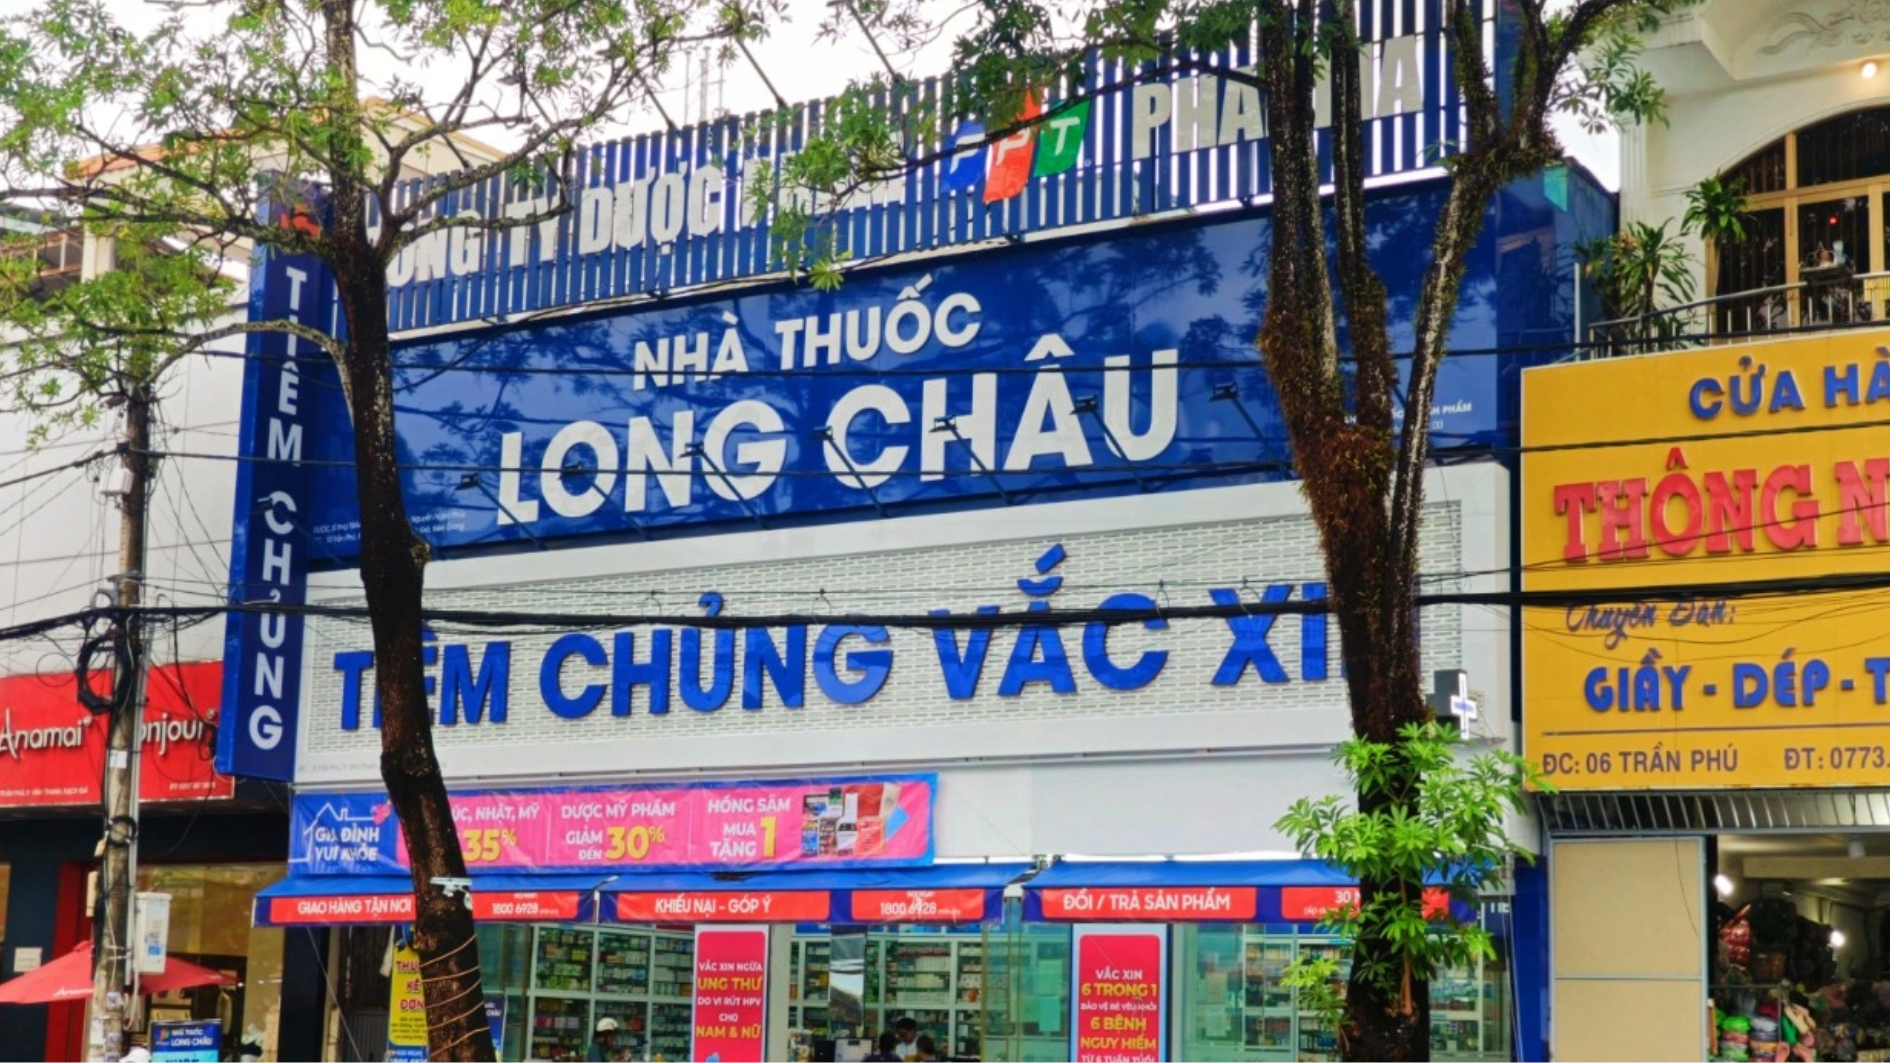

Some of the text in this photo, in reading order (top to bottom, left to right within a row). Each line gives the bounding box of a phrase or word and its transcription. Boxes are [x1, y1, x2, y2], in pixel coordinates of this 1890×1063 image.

[577, 160, 723, 256] DƯỢC
[1132, 34, 1425, 160] PHAA
[634, 274, 983, 391] NHÀ THUỐC
[1689, 355, 1805, 421] CỬA
[497, 333, 1179, 526] LONG CHÂU
[248, 266, 308, 751] TIÊM CHỦNG
[1553, 446, 1820, 564] THÔNG
[540, 591, 894, 720] CHỦNG
[928, 543, 1170, 701] VẮC
[1584, 648, 1692, 712] GIẦY
[1732, 648, 1830, 707] DÉP
[1542, 752, 1580, 775] ĐC:
[1586, 752, 1612, 775] 06
[1618, 741, 1682, 773] TRẦN
[1690, 735, 1739, 772] PHÚ
[1784, 747, 1824, 770] ĐT:
[518, 803, 541, 820] MỸ
[561, 798, 676, 823] DƯỢC MỸ PHẨM
[757, 793, 791, 813] SÂM
[565, 825, 603, 845] GIẢM
[723, 822, 757, 837] MUA
[760, 815, 777, 859] 1
[462, 828, 518, 863] 35%
[578, 846, 602, 861] ĐẾN
[605, 825, 665, 861] 30%
[709, 838, 757, 861] TẶNG
[297, 896, 412, 917] GIAO HÀNG TẬN NƠI
[655, 893, 691, 913] KHIẾU
[693, 897, 716, 918] NẠI
[727, 894, 759, 913] GÓP
[761, 894, 772, 913] Ý
[1062, 887, 1231, 911] ĐỔI / TRẢ SẢN PHẨM
[1335, 890, 1351, 904] 30
[492, 902, 514, 915] 1800
[515, 902, 539, 915] 6928
[719, 962, 734, 971] XIN
[1095, 965, 1143, 980] VẮC XIN
[697, 976, 763, 991] UNG THƯ
[1081, 982, 1158, 997] 6 TRONG 1
[697, 997, 711, 1006] DO
[713, 997, 722, 1006] VI
[742, 996, 762, 1006] HPV
[718, 1012, 739, 1023] CHO
[1090, 1013, 1147, 1034] 6 BỆNH
[696, 1024, 762, 1038] NAM & NỮ
[1081, 1033, 1156, 1050] NGUY HIỂM
